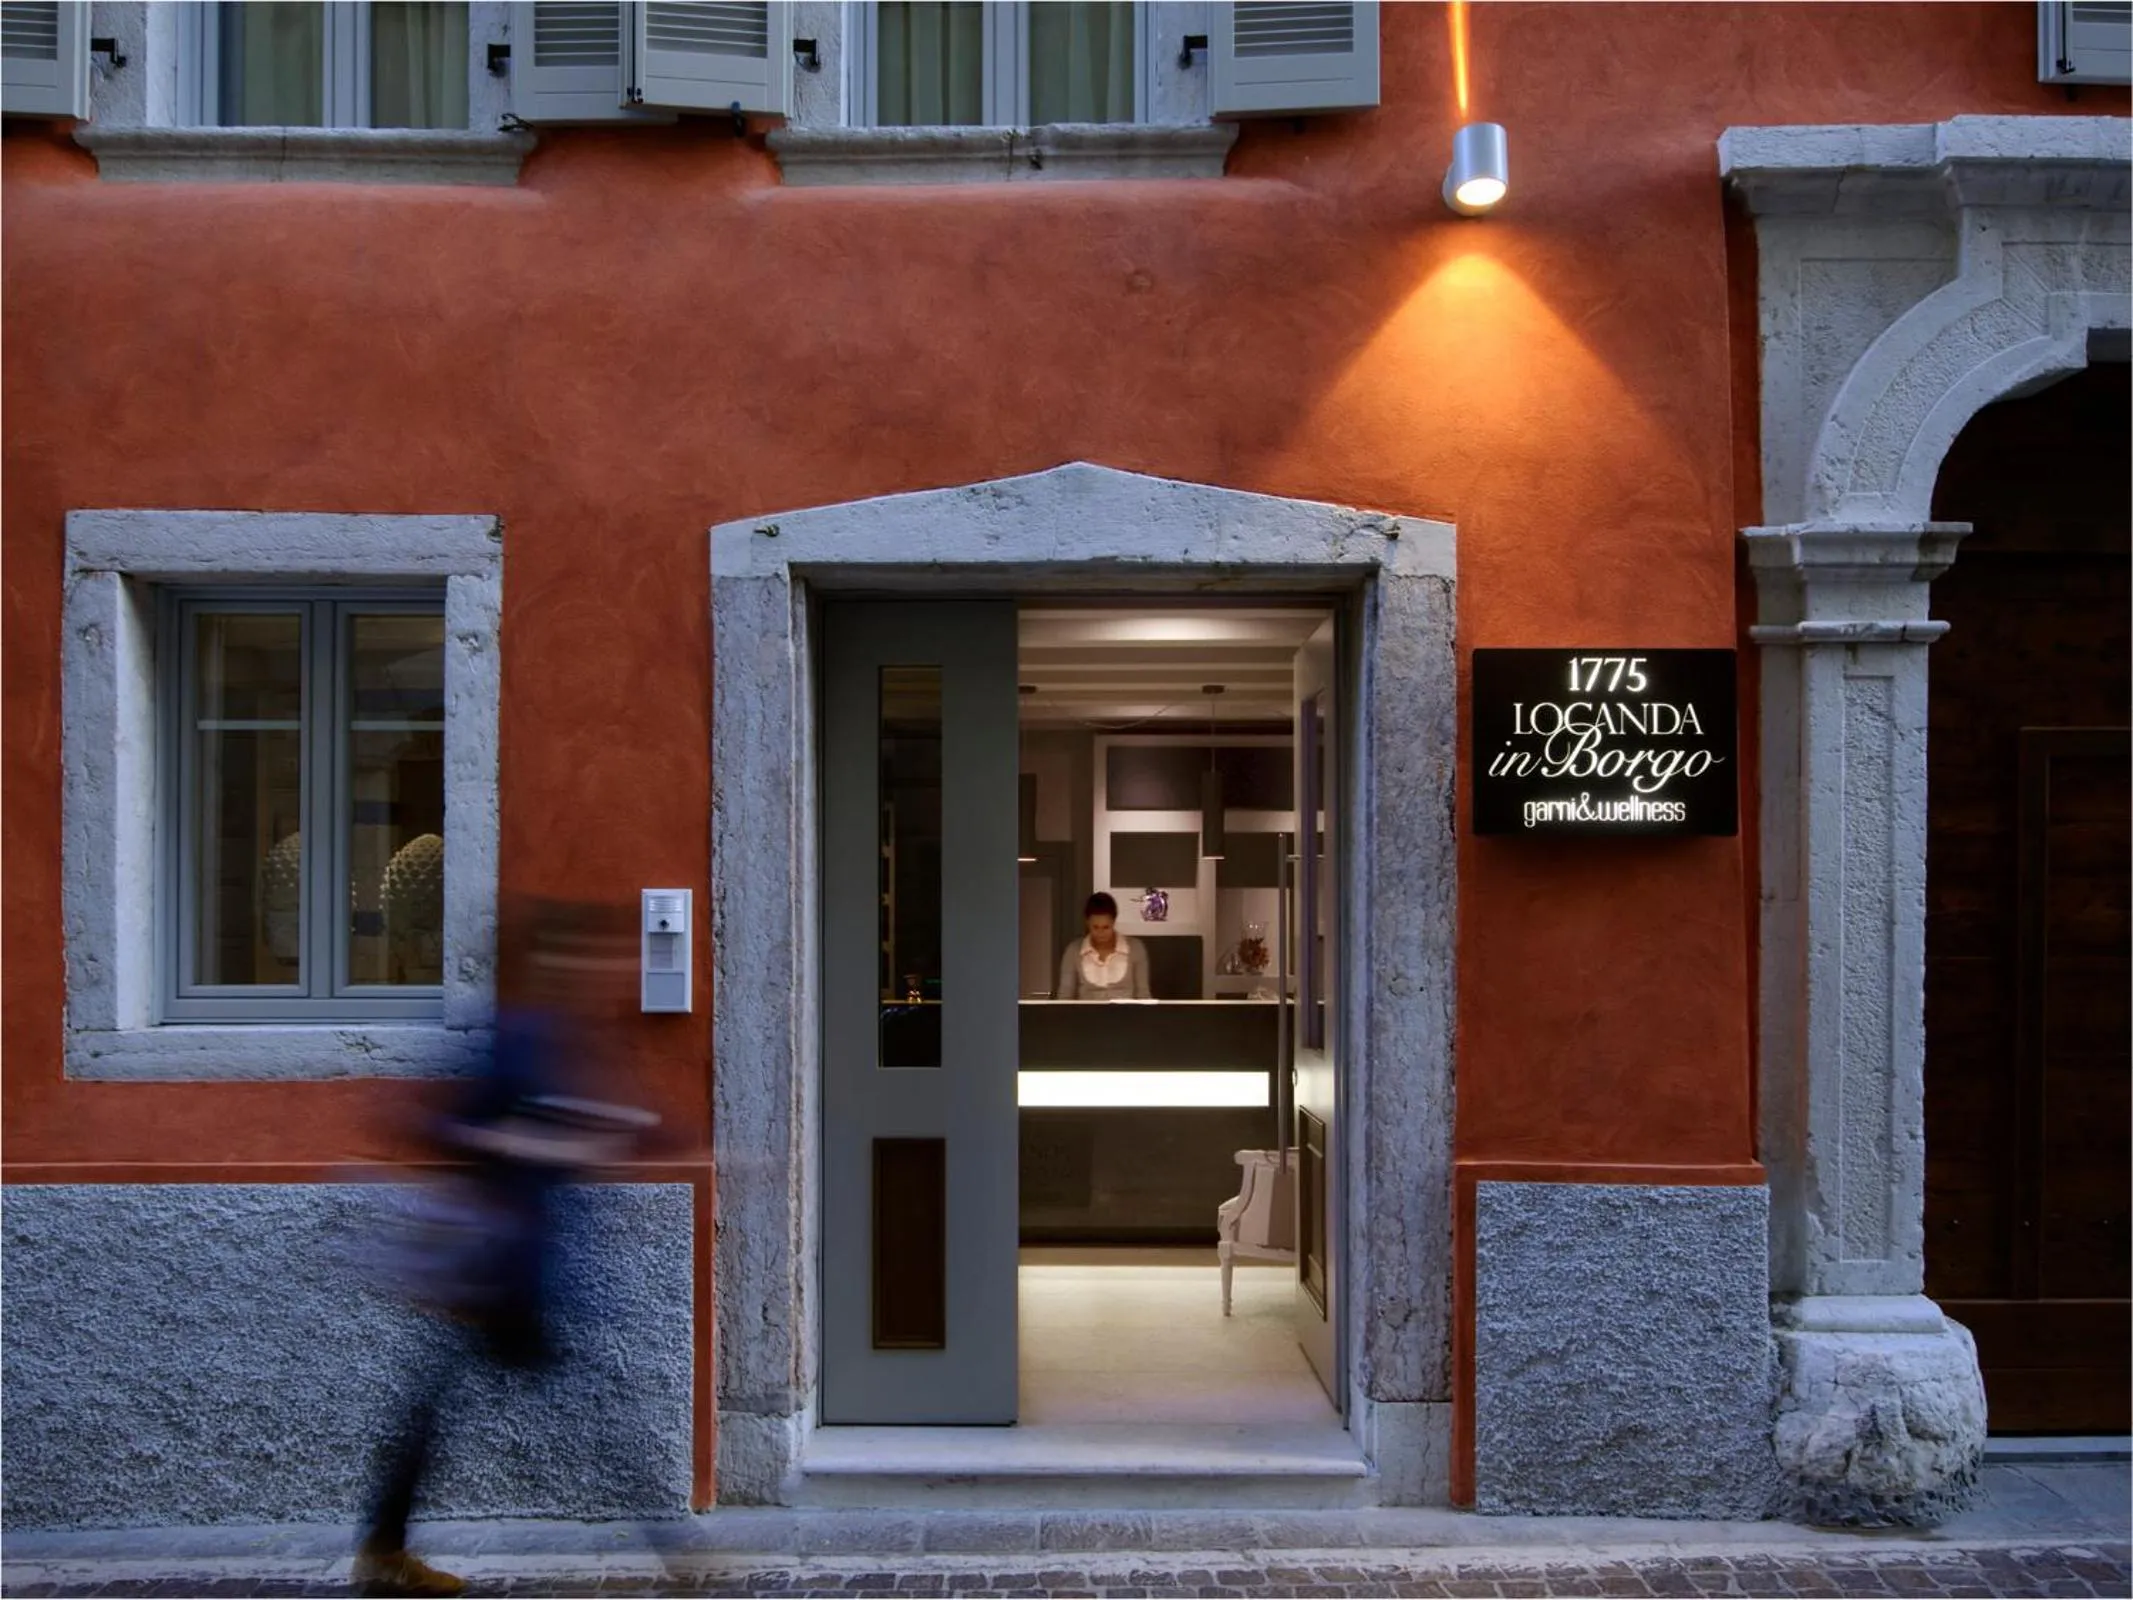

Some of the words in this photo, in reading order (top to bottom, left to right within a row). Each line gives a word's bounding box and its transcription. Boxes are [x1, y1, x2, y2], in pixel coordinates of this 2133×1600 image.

[1568, 656, 1648, 693] 1775
[1512, 702, 1704, 735] LOCANDA
[1488, 740, 1542, 777] in
[1541, 722, 1726, 793] Borgo
[1523, 792, 1686, 828] garni&wellness
